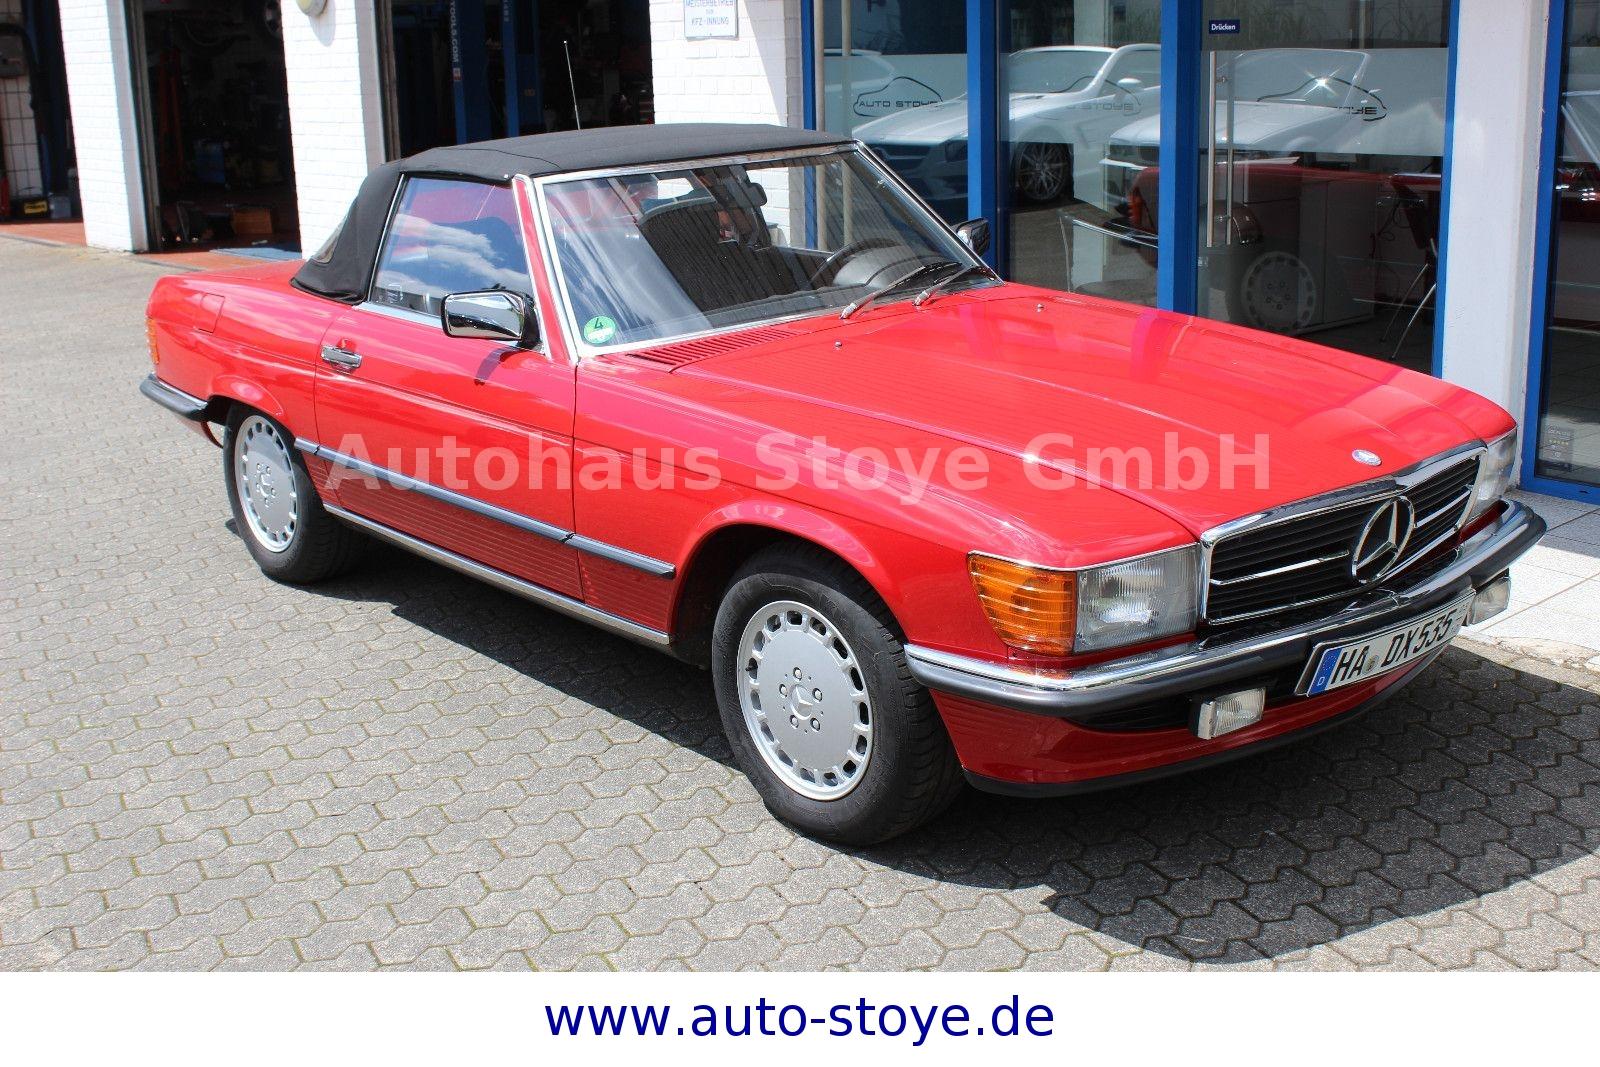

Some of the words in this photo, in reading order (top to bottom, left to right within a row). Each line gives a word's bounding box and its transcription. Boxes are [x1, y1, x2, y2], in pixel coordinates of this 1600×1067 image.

[1211, 23, 1236, 31] Drücken
[859, 100, 891, 108] AUTO
[1330, 645, 1370, 685] HA
